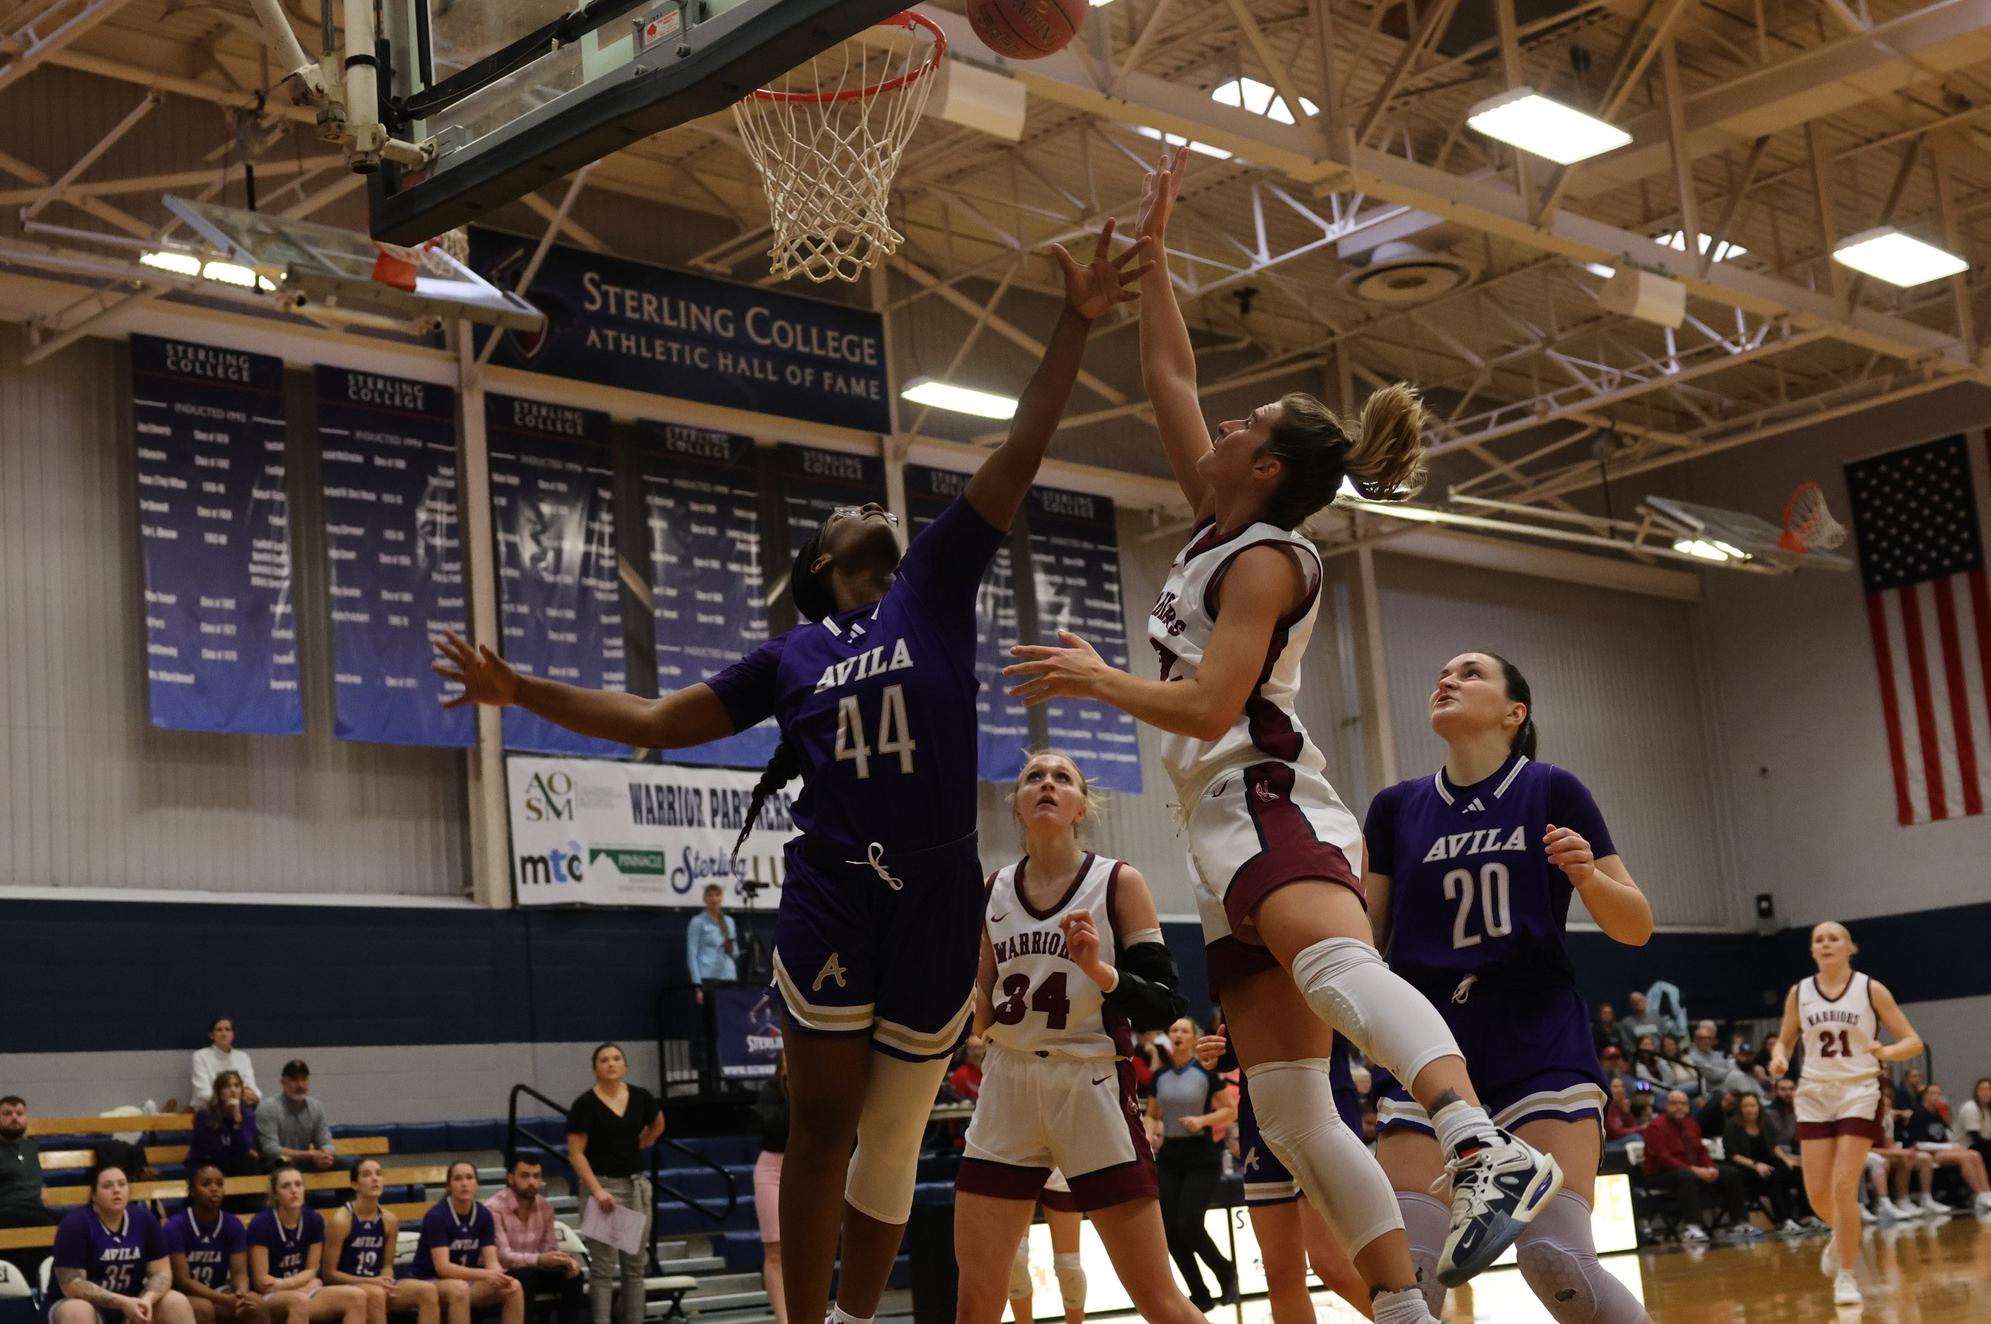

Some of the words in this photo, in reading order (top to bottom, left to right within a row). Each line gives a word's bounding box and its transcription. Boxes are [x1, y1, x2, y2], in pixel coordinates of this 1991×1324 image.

[582, 271, 735, 338] STERLING
[746, 307, 878, 366] COLLEGE
[166, 343, 250, 369] STERLING
[166, 357, 251, 383] COLLEGE
[586, 328, 709, 369] ATHLETIC
[718, 351, 777, 382] HALL
[786, 363, 815, 388] OF
[823, 370, 881, 400] FAME
[346, 373, 424, 398] STERLING
[347, 386, 425, 411] COLLEGE
[512, 399, 583, 423] STERLING
[513, 415, 584, 437] COLLEGE
[813, 637, 914, 695] AVILA
[834, 683, 916, 780] 44
[629, 783, 706, 828] WARRIOR
[1422, 825, 1527, 864] AVILA
[520, 849, 583, 885] mtc
[1442, 862, 1512, 950] 20
[993, 931, 1075, 963] WARRIO
[994, 972, 1069, 1029] 34
[1808, 1011, 1859, 1027] WARRIORS
[1820, 1030, 1851, 1058] 21
[99, 1246, 141, 1262] AVILA
[188, 1250, 222, 1263] AVILA
[355, 1250, 378, 1277] 12
[102, 1263, 136, 1291] 35
